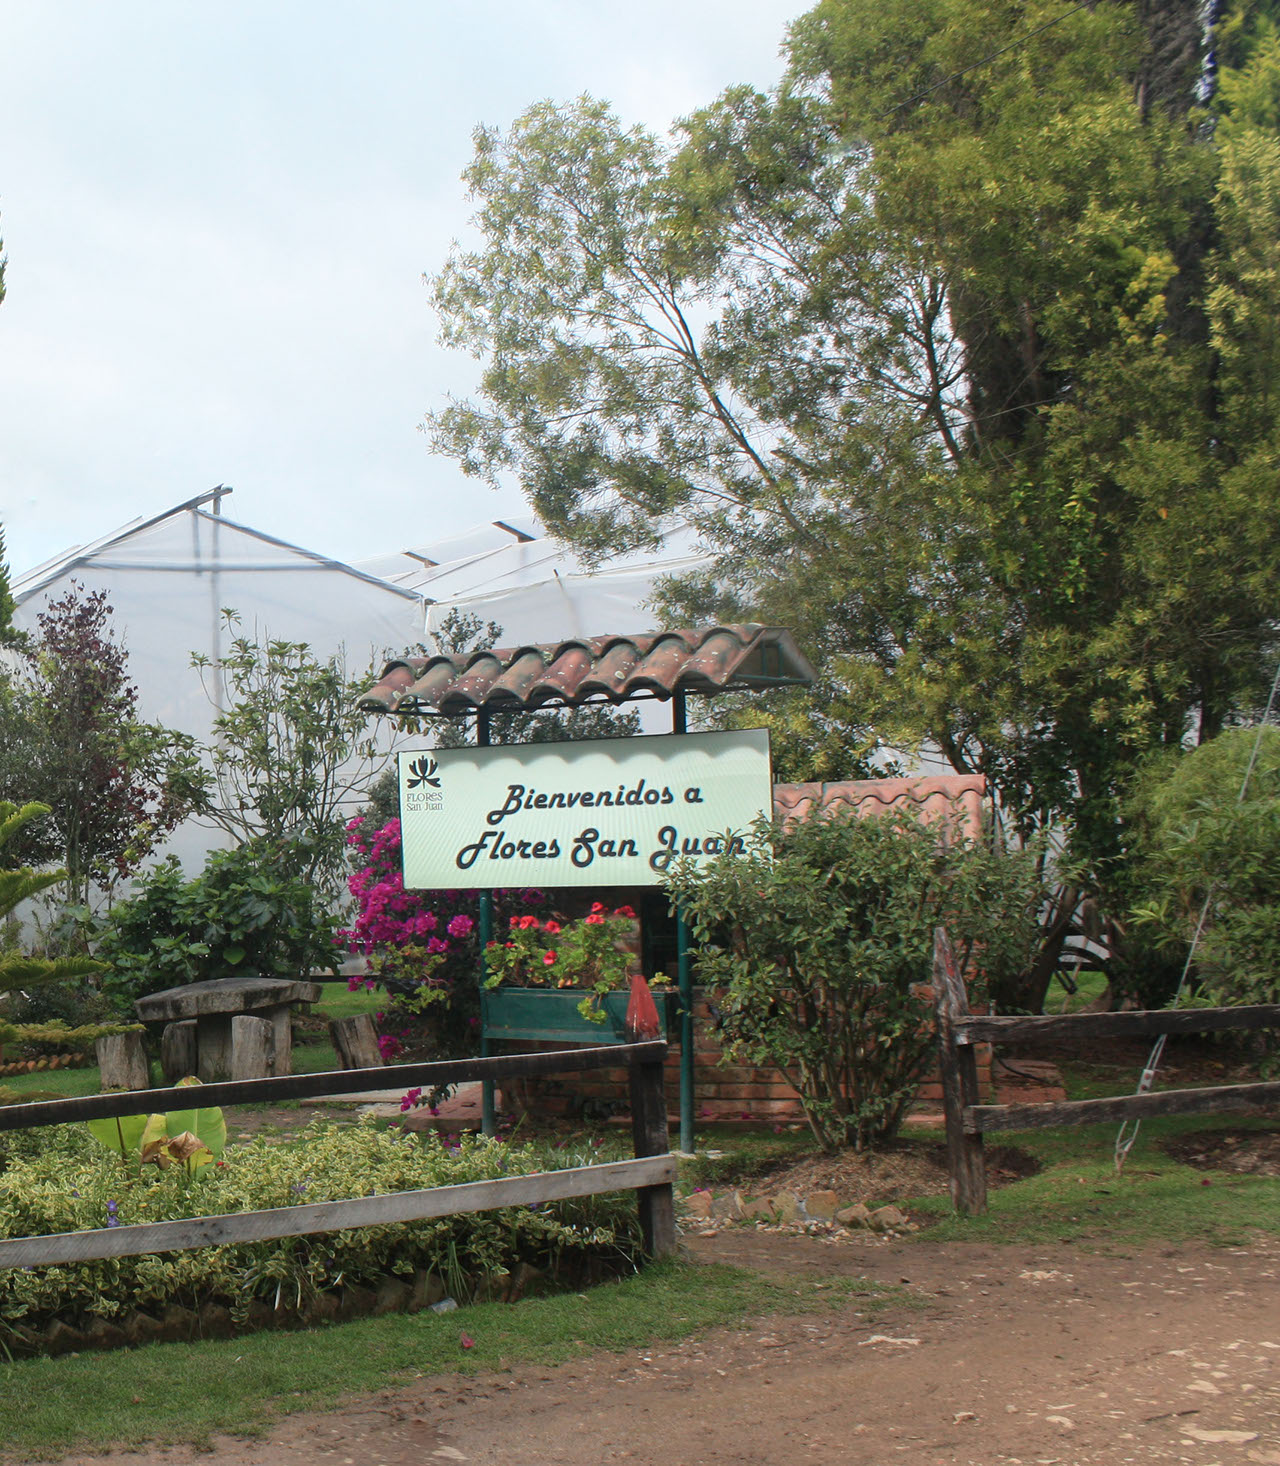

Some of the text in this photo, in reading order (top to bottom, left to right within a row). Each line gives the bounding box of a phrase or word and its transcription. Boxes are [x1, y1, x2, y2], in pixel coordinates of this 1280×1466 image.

[406, 801, 443, 811] San Juan
[486, 778, 704, 826] Bienvenidos a
[455, 825, 748, 872] Flores San Juan
